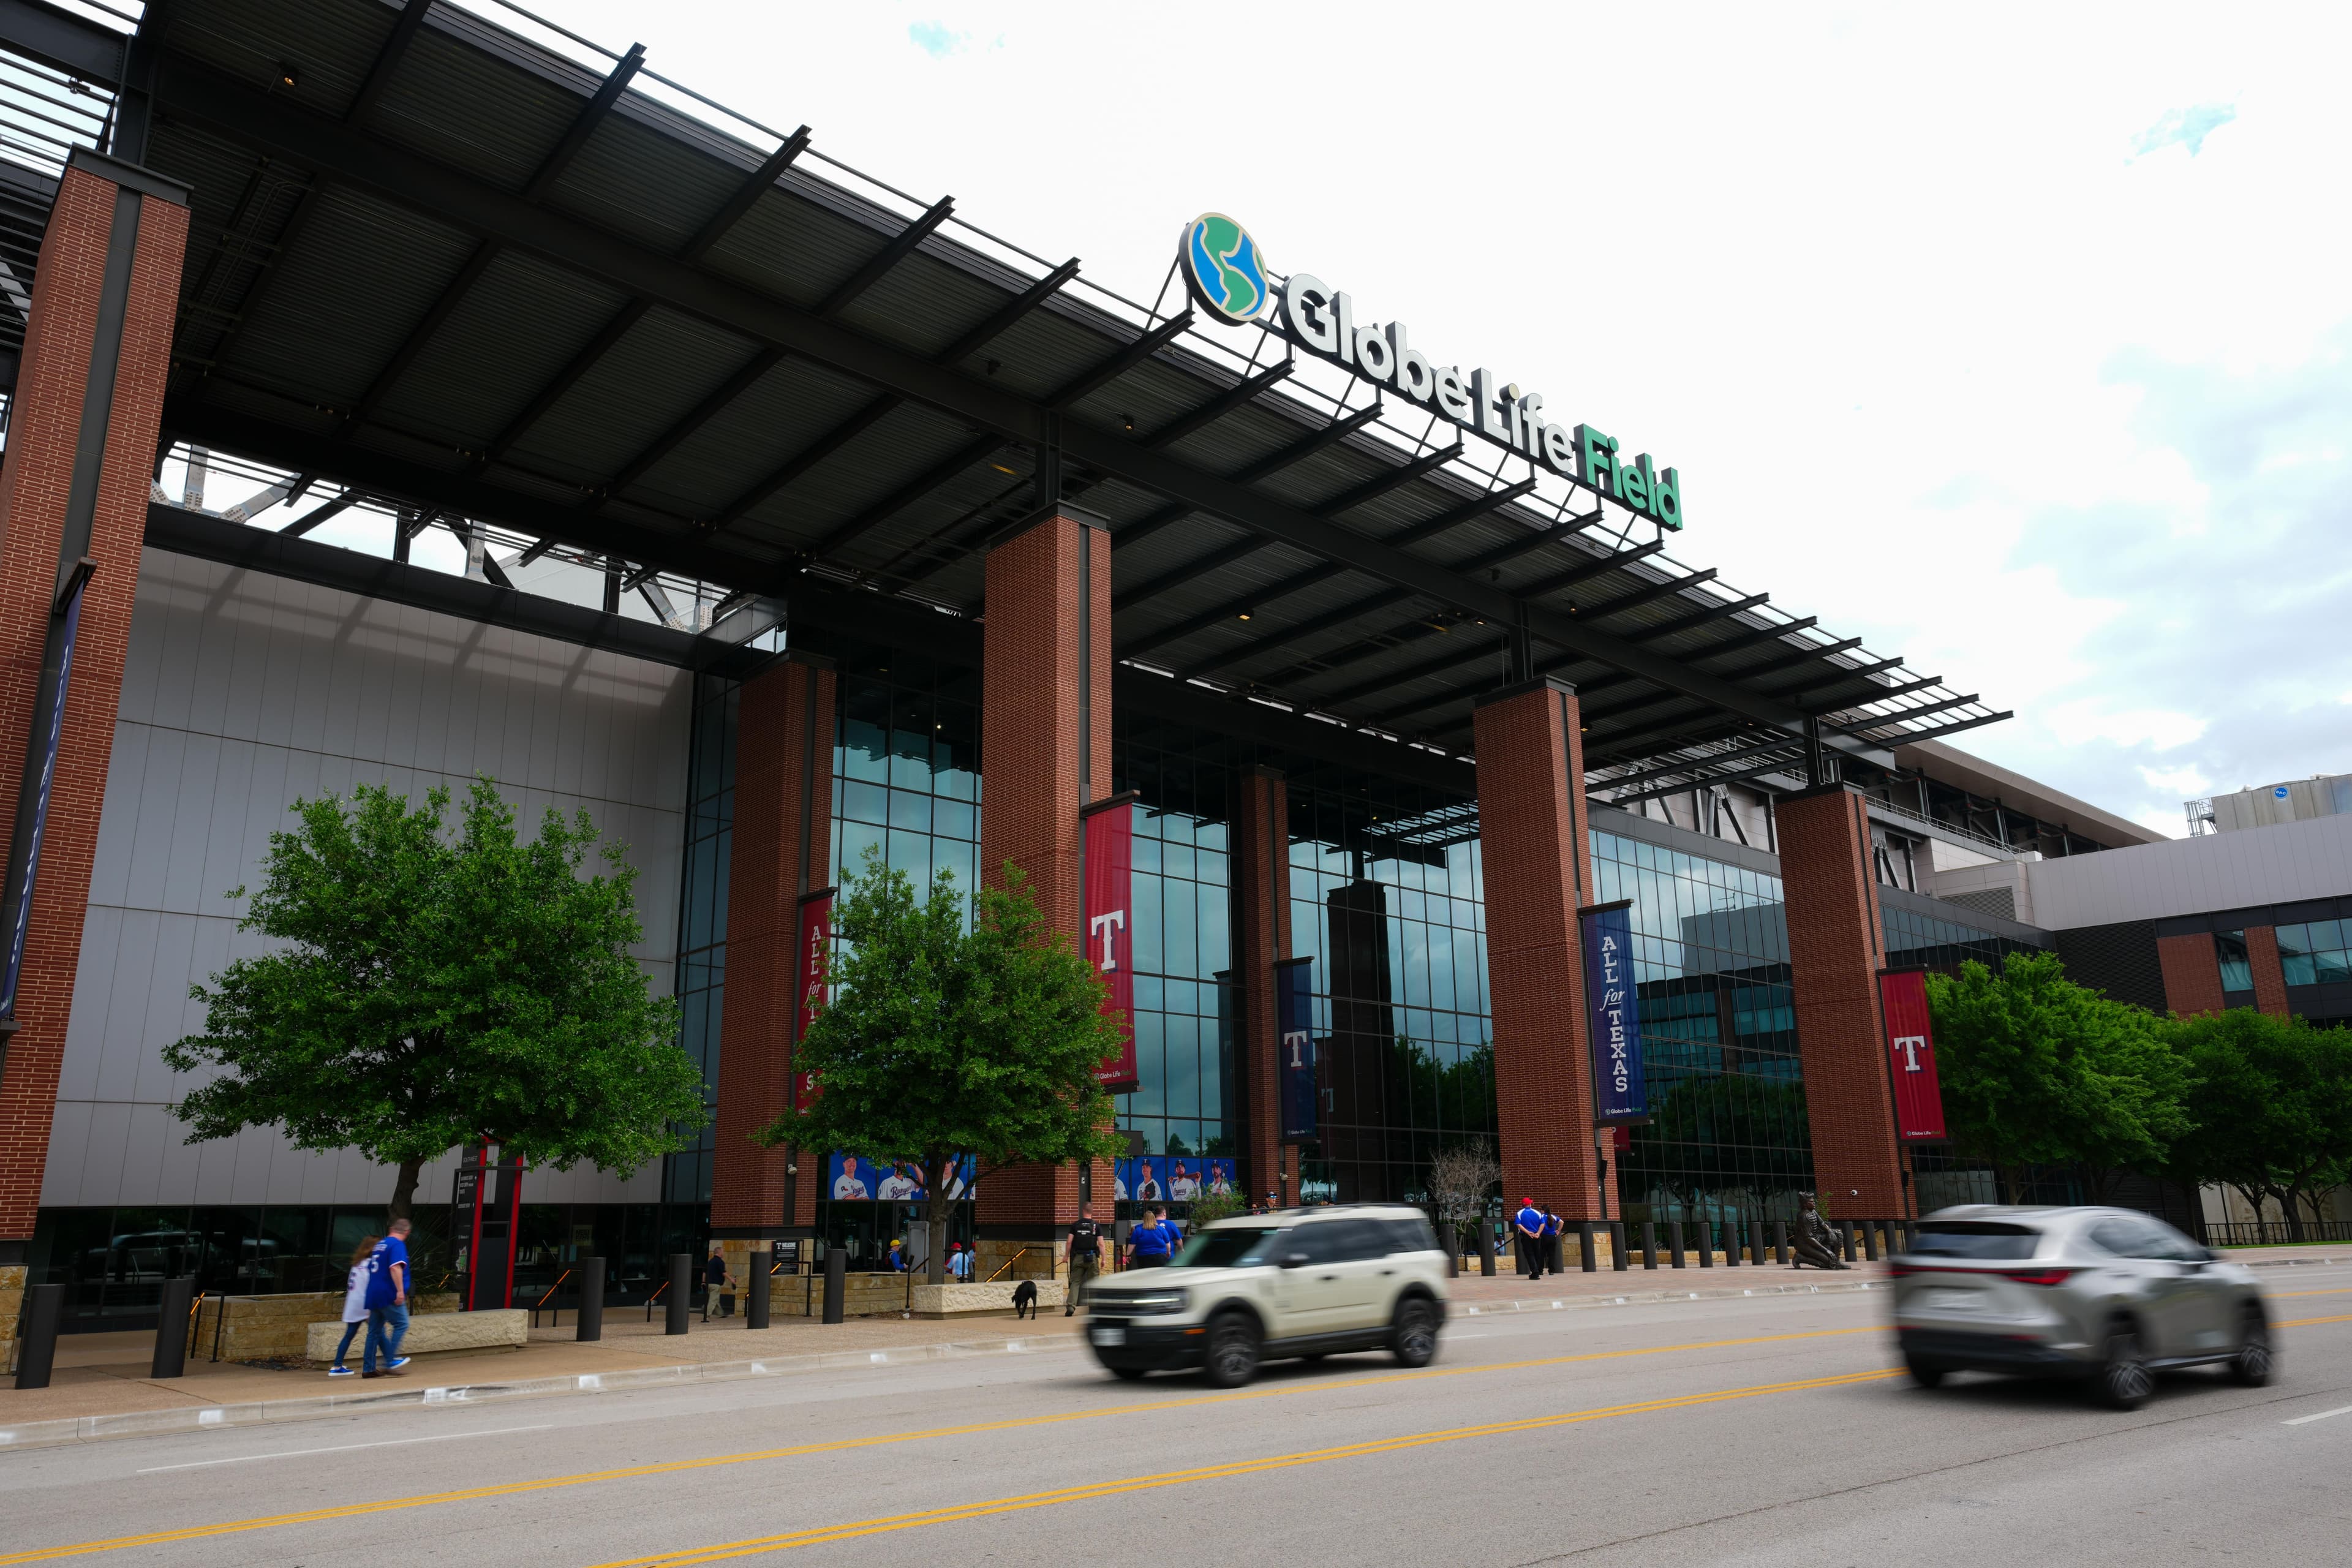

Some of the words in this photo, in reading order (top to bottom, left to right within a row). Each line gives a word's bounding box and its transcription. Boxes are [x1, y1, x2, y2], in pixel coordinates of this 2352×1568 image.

[1279, 274, 1468, 421] Globe
[1471, 368, 1573, 472] Life
[1574, 424, 1683, 532] Field
[811, 925, 821, 975] ALL
[1091, 910, 1125, 971] T
[1602, 936, 1618, 983] ALL
[805, 981, 822, 1004] for
[1599, 988, 1625, 1011] for
[1284, 1031, 1307, 1068] T
[1608, 1009, 1628, 1092] TEXAS
[1894, 1035, 1926, 1071] T
